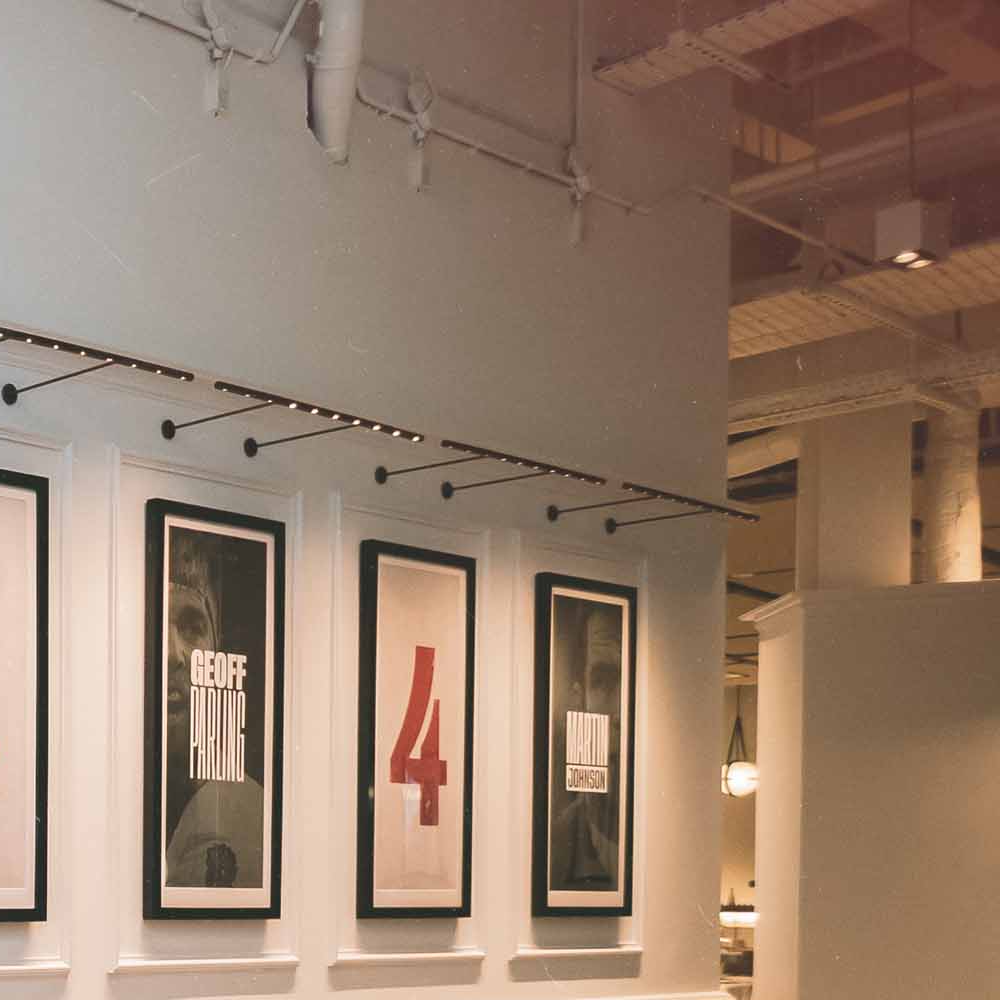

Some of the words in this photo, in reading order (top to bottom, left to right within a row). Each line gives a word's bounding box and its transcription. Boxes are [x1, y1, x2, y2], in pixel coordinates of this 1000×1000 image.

[190, 649, 247, 690] GEOFF
[189, 686, 246, 782] PARLING
[389, 645, 448, 826] 4
[566, 710, 608, 766] MARTIN
[567, 767, 606, 790] JOHNSON
